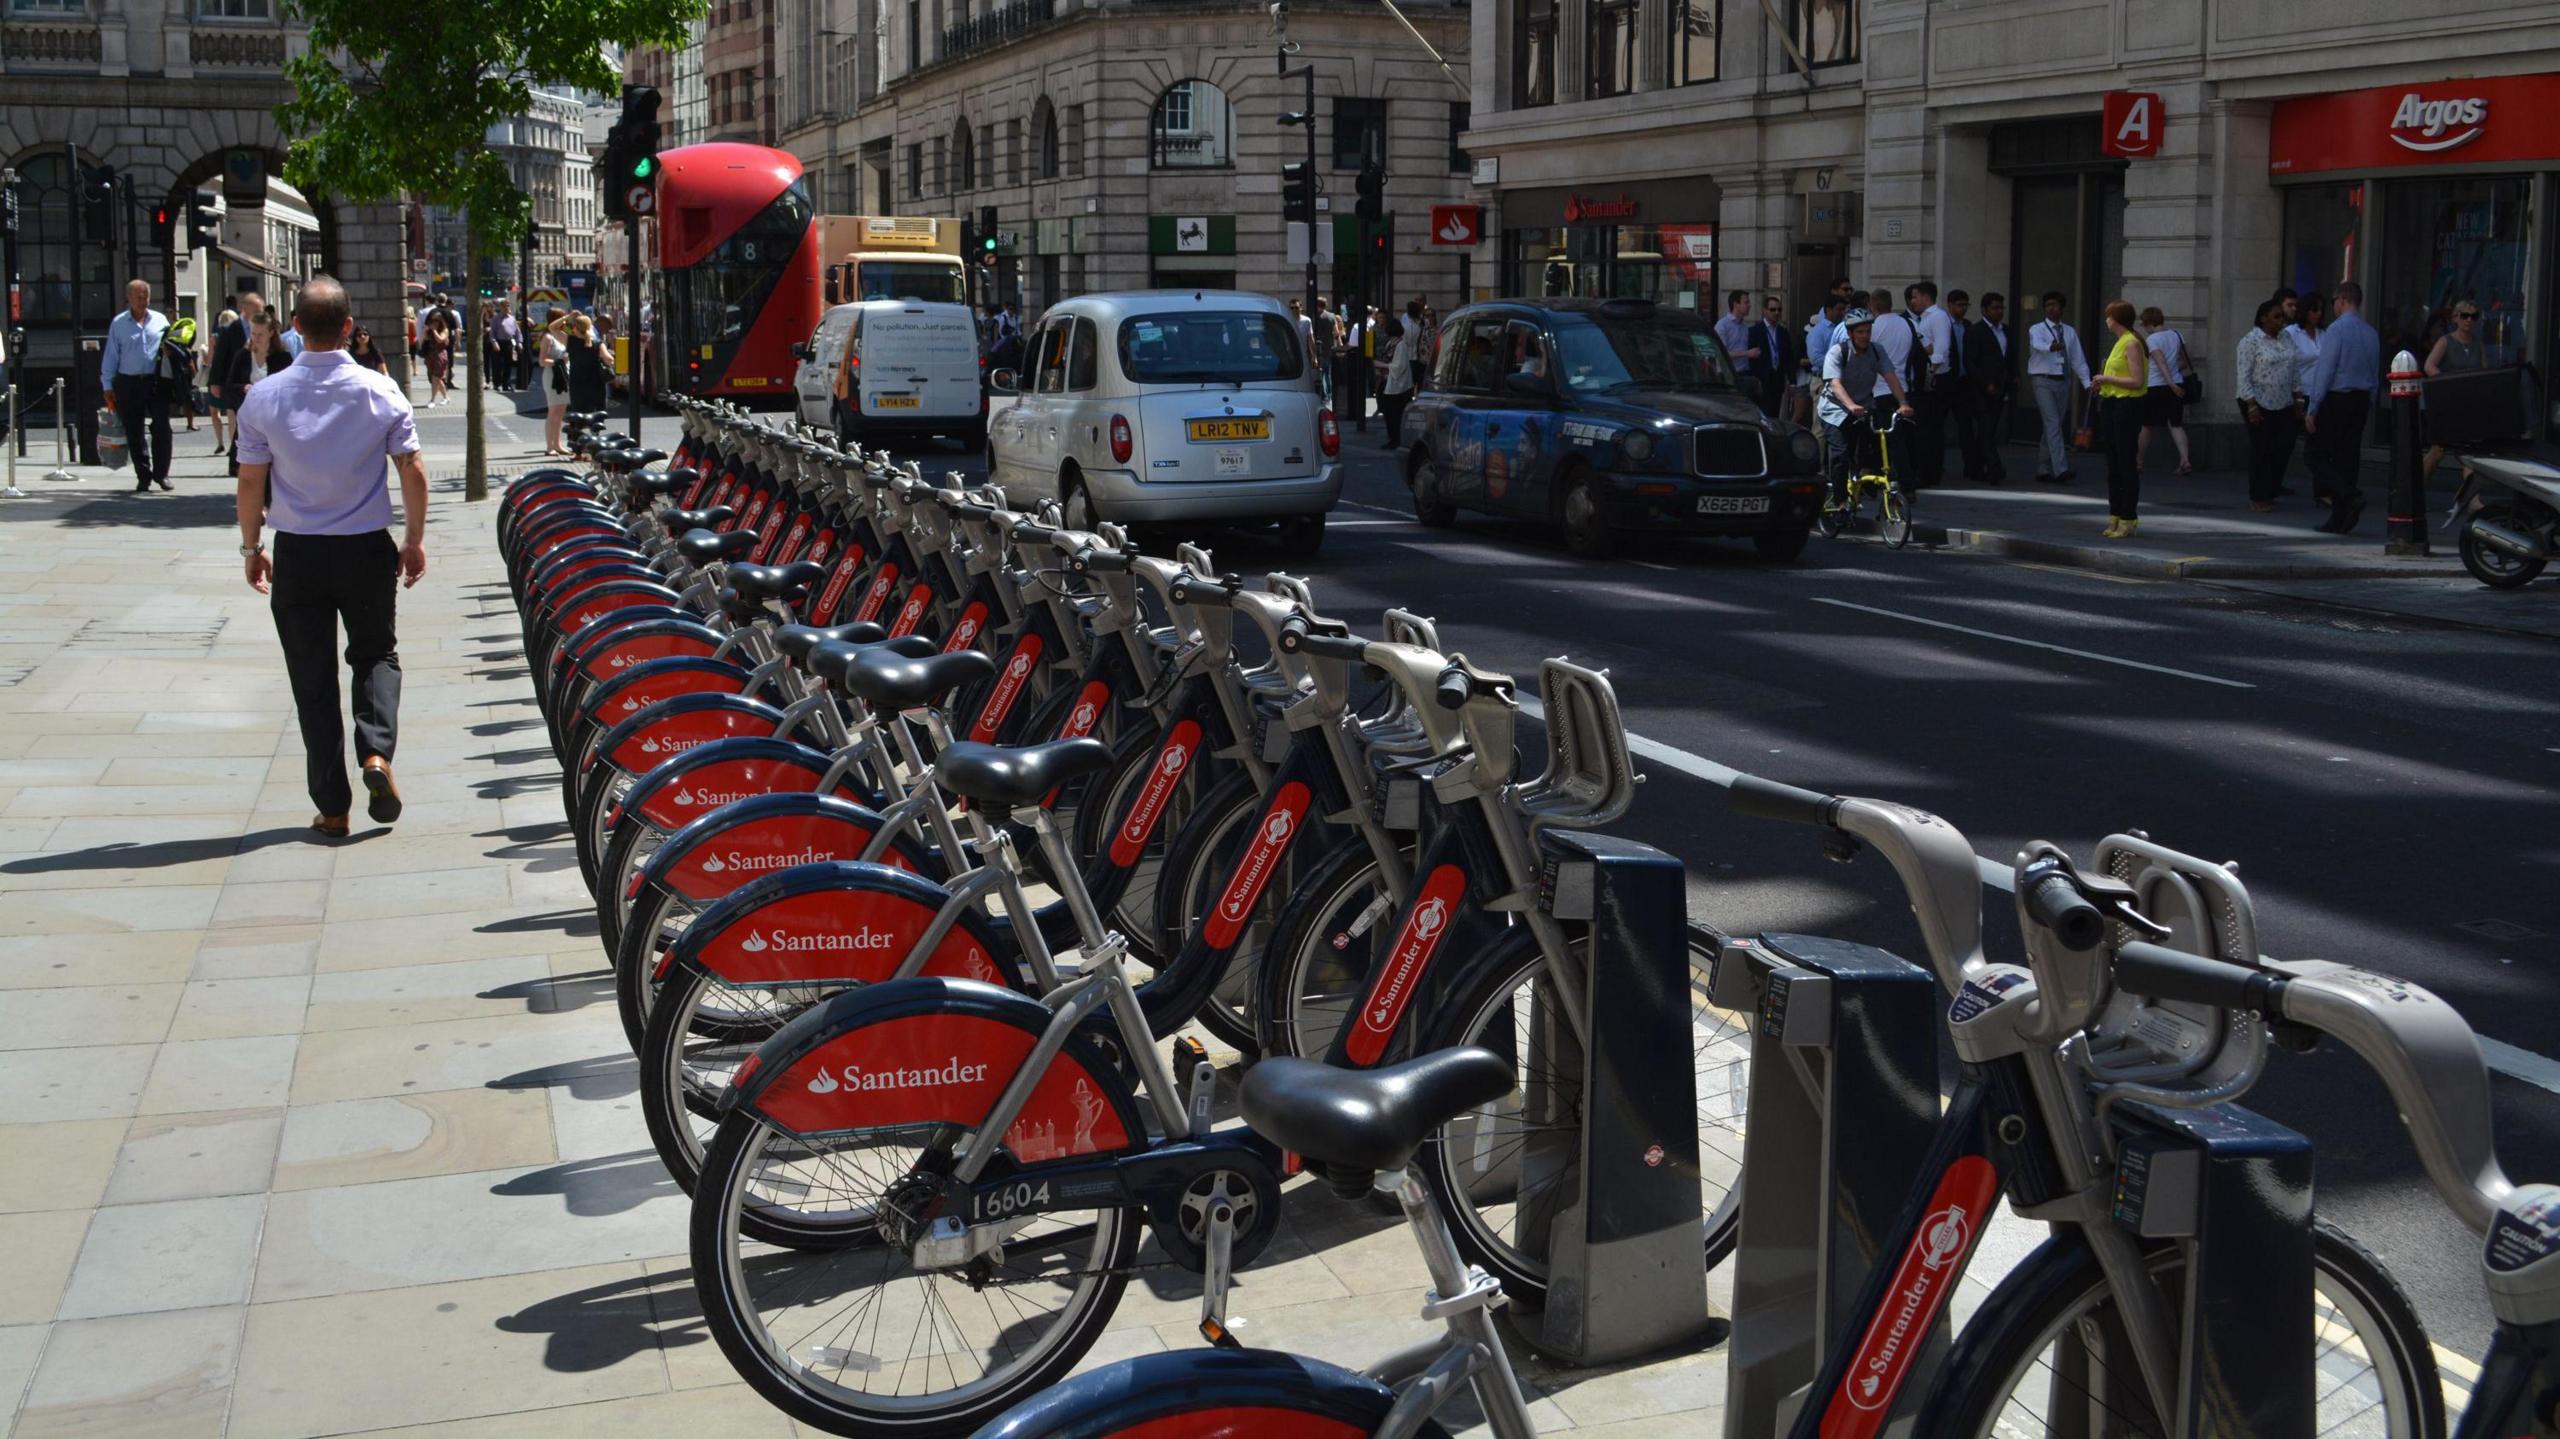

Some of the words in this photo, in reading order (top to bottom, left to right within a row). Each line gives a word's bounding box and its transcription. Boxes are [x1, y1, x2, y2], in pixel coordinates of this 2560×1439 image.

[2117, 97, 2149, 140] A
[2390, 93, 2488, 137] Argos
[1816, 168, 1834, 190] 67
[1580, 192, 1637, 218] Santander
[744, 242, 756, 260] 8
[1198, 423, 1230, 437] LR12
[1233, 422, 1259, 436] TNV
[1220, 457, 1245, 465] 97617
[1700, 498, 1738, 511] X626
[1741, 498, 1769, 511] PGT
[990, 678, 1015, 718] Santander
[1135, 776, 1168, 826] Santander
[1234, 845, 1271, 902] Santander
[771, 926, 894, 951] Santander
[1379, 941, 1422, 1009] Santander
[843, 1056, 987, 1092] Santander
[973, 1180, 1051, 1219] 16604
[1936, 1225, 1953, 1251] CYCLES
[2500, 1225, 2547, 1253] CAUTION
[1869, 1272, 1931, 1374] Santander
